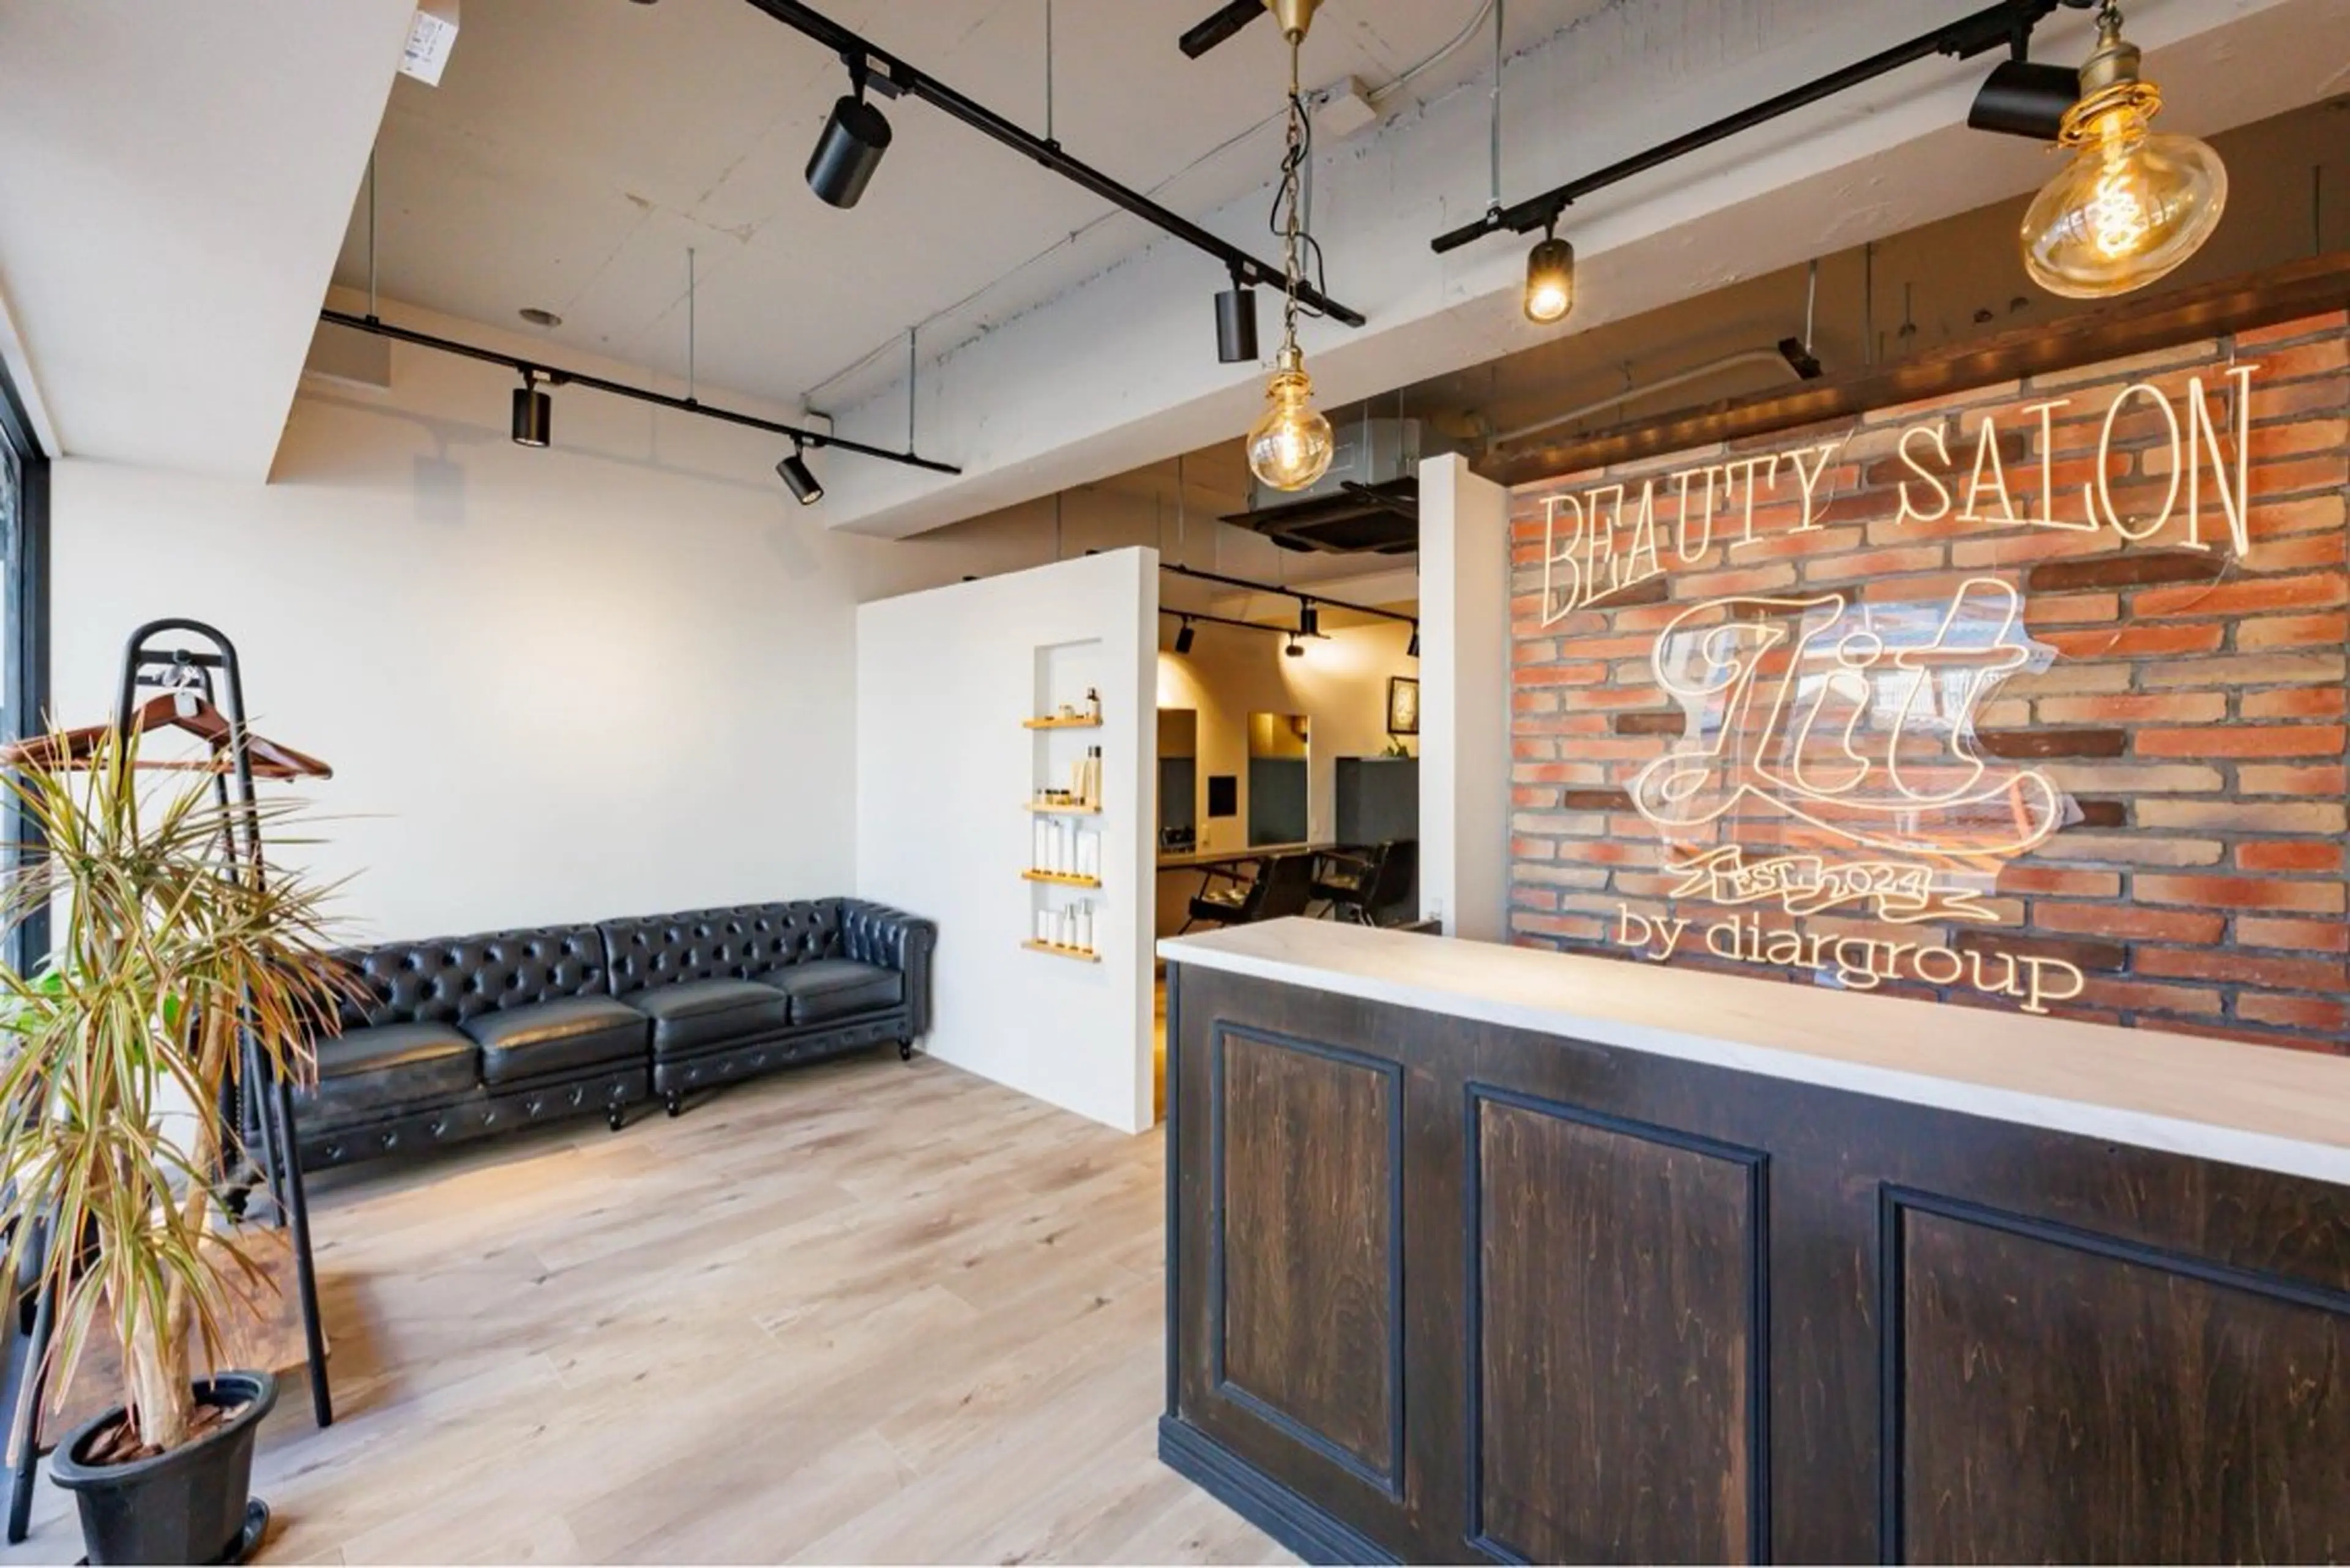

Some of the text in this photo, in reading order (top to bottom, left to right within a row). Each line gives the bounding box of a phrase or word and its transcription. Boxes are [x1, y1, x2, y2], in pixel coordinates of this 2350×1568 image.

[1539, 364, 2261, 630] BEAUTY SALON
[1821, 864, 1924, 899] 2024
[1616, 903, 2084, 1014] by diargroup
